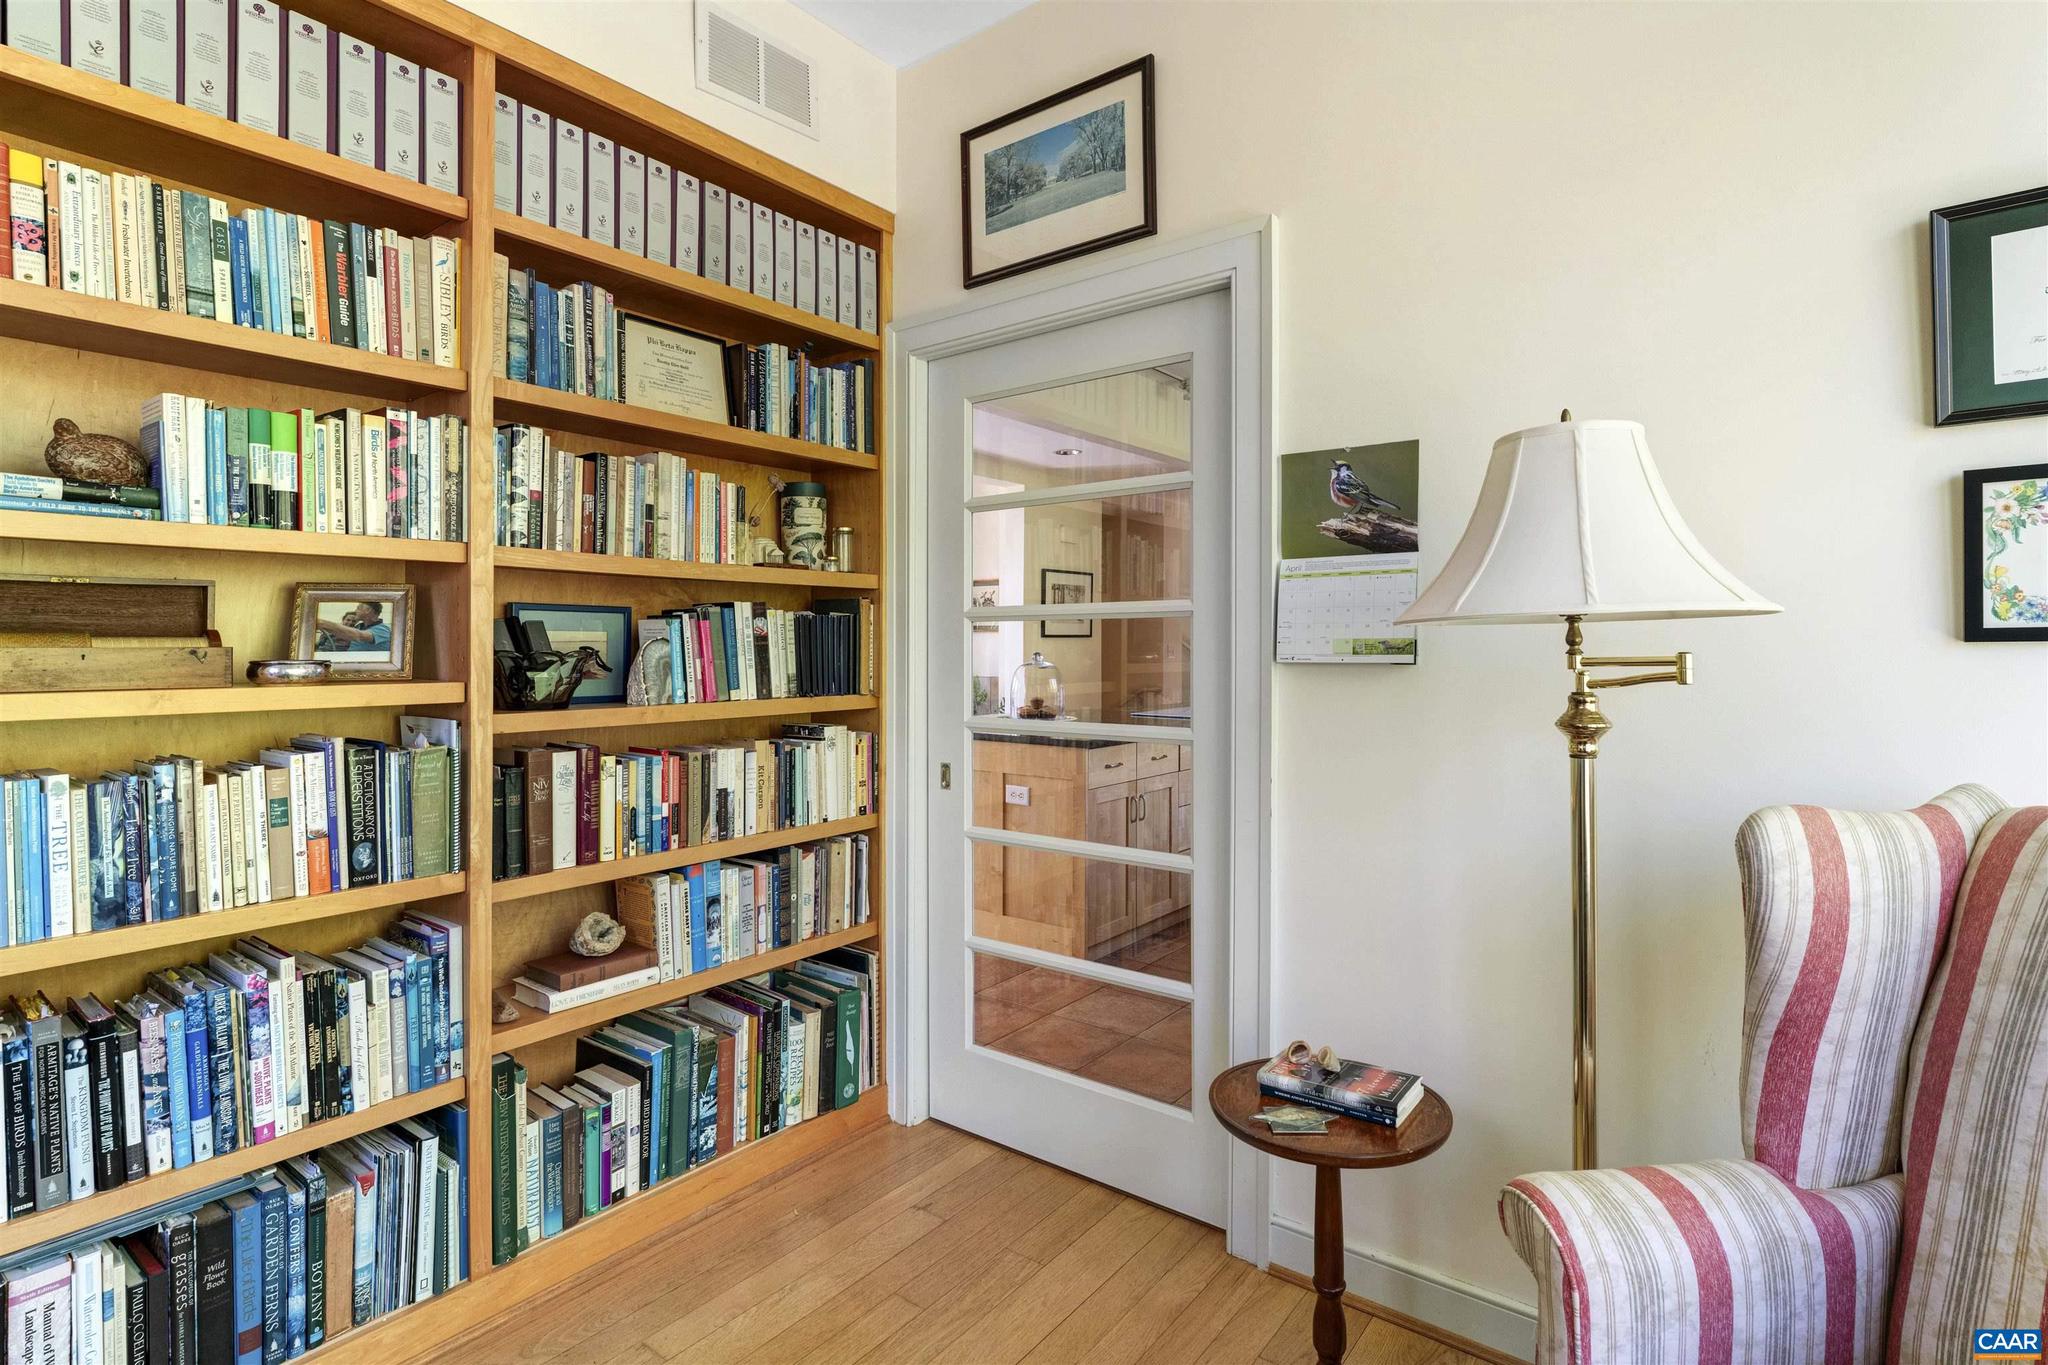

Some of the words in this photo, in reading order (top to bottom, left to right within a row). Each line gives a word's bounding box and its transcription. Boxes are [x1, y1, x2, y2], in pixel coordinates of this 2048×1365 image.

[70, 191, 82, 240] Extraordinary
[74, 242, 83, 266] Insects
[122, 223, 133, 259] Freshwater
[215, 226, 226, 256] CASEY
[124, 258, 135, 299] Invertebrates
[335, 252, 348, 299] Warbler
[339, 298, 350, 327] Guide
[440, 274, 451, 322] SIBLEY
[371, 430, 380, 451] Birds
[126, 783, 135, 804] Bolen
[232, 781, 240, 796] THE
[364, 771, 374, 825] DICTIONARY
[532, 780, 550, 790] NIV
[55, 804, 63, 820] THE
[74, 793, 83, 812] THE
[233, 798, 241, 833] PROPHET
[351, 766, 364, 841] SUPERSTITIONS
[75, 812, 84, 855] COMPLETE
[126, 819, 139, 842] Like
[167, 804, 176, 840] BRINGING
[366, 826, 375, 839] OF
[51, 821, 69, 874] TREE
[77, 857, 86, 888] BIRDER
[127, 857, 140, 880] Tree
[353, 874, 377, 882] OXFORD
[437, 967, 445, 1000] Well-Tended
[214, 993, 229, 1014] DARKE
[216, 1022, 230, 1050] TALLAMY
[394, 1001, 404, 1050] BEGONIAS
[410, 1015, 418, 1042] TREES
[194, 1041, 202, 1066] GARDEN
[218, 1059, 229, 1071] THE
[789, 1050, 798, 1086] RECIPES
[12, 1063, 23, 1082] THE
[47, 1044, 59, 1100] ARMITAGE'S
[77, 1075, 85, 1086] The
[219, 1071, 230, 1092] LIVING
[498, 1073, 508, 1094] THE
[12, 1085, 24, 1101] LIFE
[39, 1079, 47, 1108] AMERICAN
[196, 1067, 204, 1110] PERENNIALS
[254, 1071, 263, 1108] SOUTHEAST
[264, 1081, 272, 1105] PLANTS
[14, 1103, 24, 1113] OF
[49, 1102, 60, 1137] NATIVE
[78, 1086, 89, 1132] KINGDOM
[221, 1093, 232, 1129] LANDSCAPE
[499, 1093, 509, 1118] NEW
[642, 1099, 650, 1118] BIRD
[13, 1115, 26, 1149] BIRDS
[71, 1120, 79, 1149] Stephenson
[642, 1119, 650, 1159] BEHAVIOR
[17, 1150, 25, 1165] David
[50, 1139, 62, 1174] PLANTS
[81, 1135, 90, 1164] FUNGI
[500, 1119, 510, 1194] INTERNATIONAL
[17, 1165, 27, 1198] Attenborough
[526, 1160, 540, 1230] NATURALIST
[424, 1184, 432, 1218] MEDICINE
[502, 1198, 511, 1225] ATLAS
[172, 1237, 192, 1248] DARKE
[174, 1232, 191, 1242] RICK
[265, 1213, 278, 1283] GARDEN
[289, 1217, 300, 1275] CONIFERS
[207, 1259, 226, 1272] Wild
[241, 1251, 254, 1270] Life
[279, 1262, 284, 1270] OF
[171, 1253, 188, 1311] grasses
[202, 1268, 229, 1285] Flower
[206, 1277, 226, 1290] Book
[241, 1272, 255, 1284] of
[242, 1288, 256, 1323] Birds
[311, 1260, 323, 1323] BOTANY
[43, 1301, 56, 1342] Manual
[84, 1294, 97, 1349] Watercolor
[265, 1284, 279, 1333] FERNS
[43, 1343, 56, 1356] of
